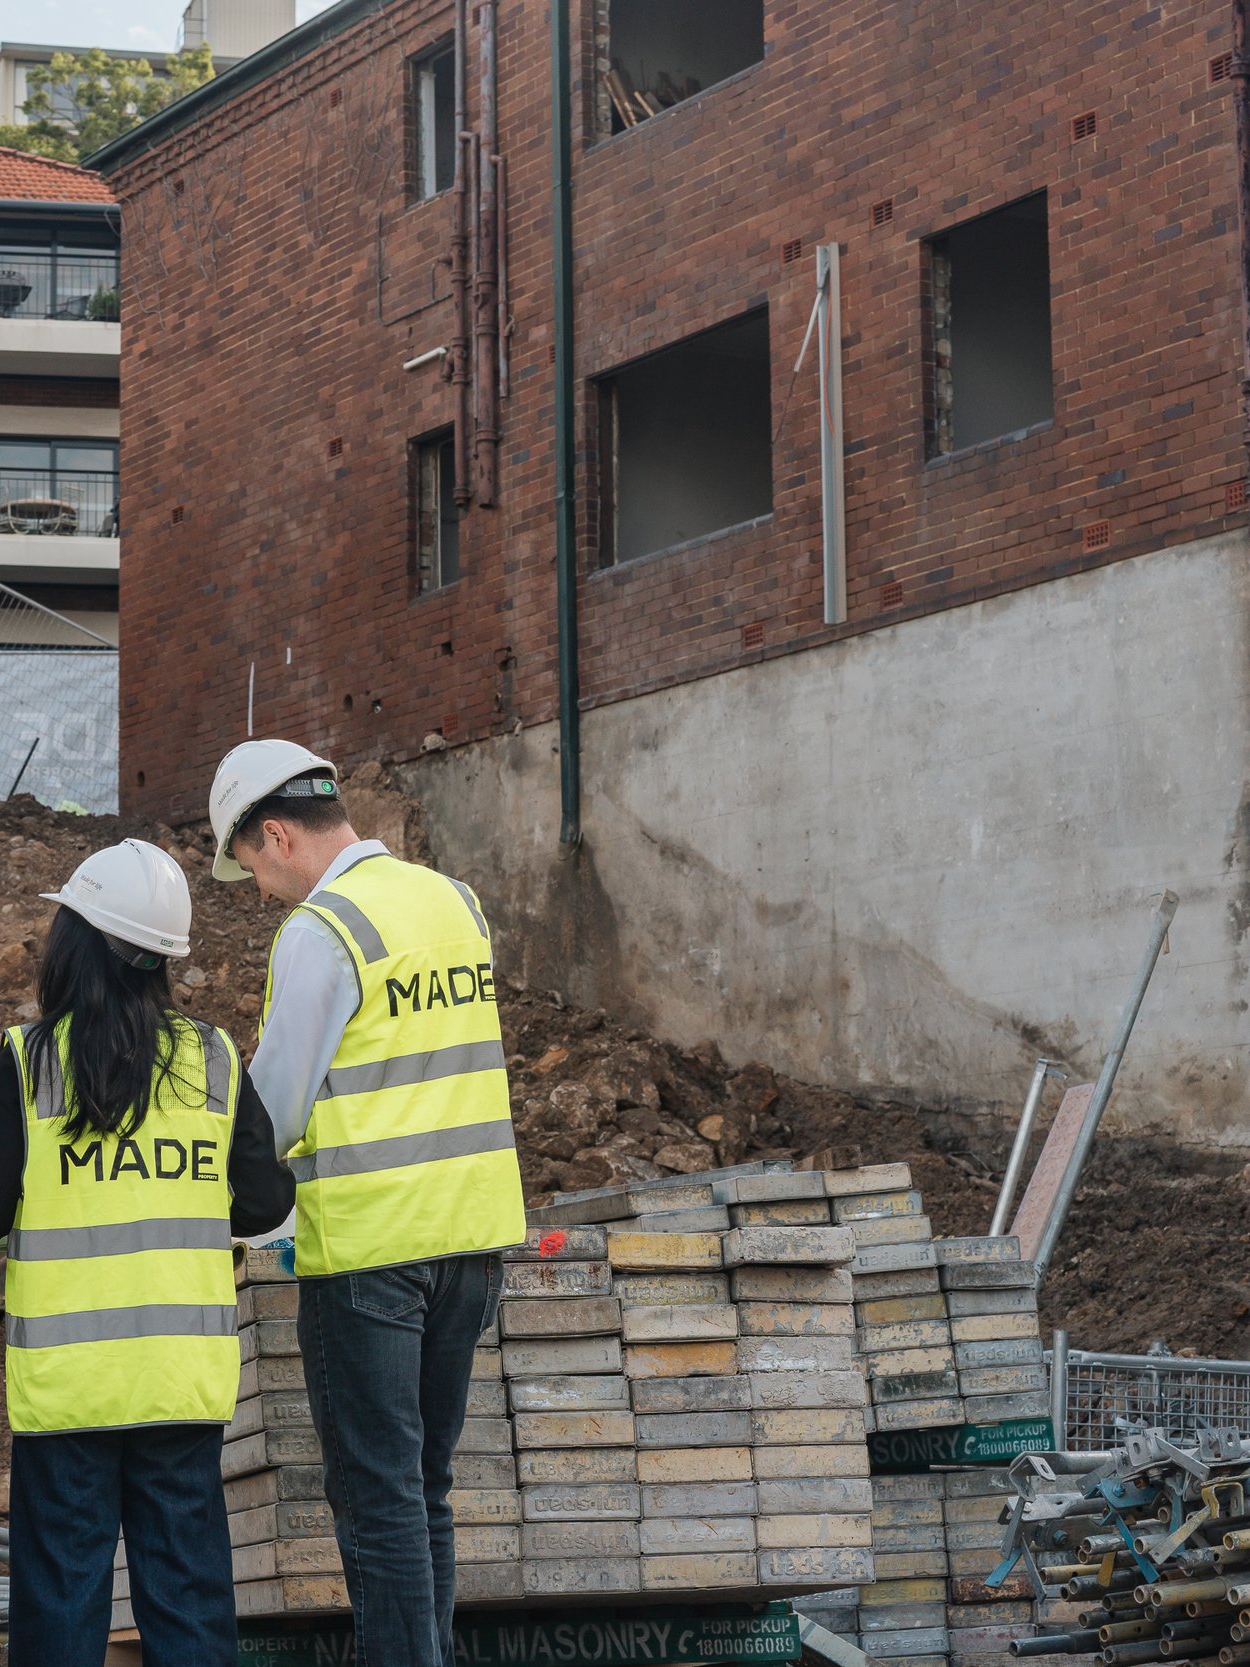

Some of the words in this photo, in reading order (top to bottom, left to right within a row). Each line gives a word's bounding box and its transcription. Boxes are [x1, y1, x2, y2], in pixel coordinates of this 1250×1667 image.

[385, 963, 498, 1017] MADE
[59, 1138, 219, 1186] MADE
[981, 1426, 1004, 1440] FOR
[1006, 1424, 1047, 1438] PICKUP
[872, 1430, 960, 1464] SONRY
[978, 1438, 1050, 1456] 1800066089
[702, 1620, 733, 1634] FOR
[737, 1619, 791, 1633] PICKUP
[237, 1637, 310, 1652] ROPERTY
[499, 1621, 672, 1662] MASONRY
[696, 1637, 795, 1656] 1800066089
